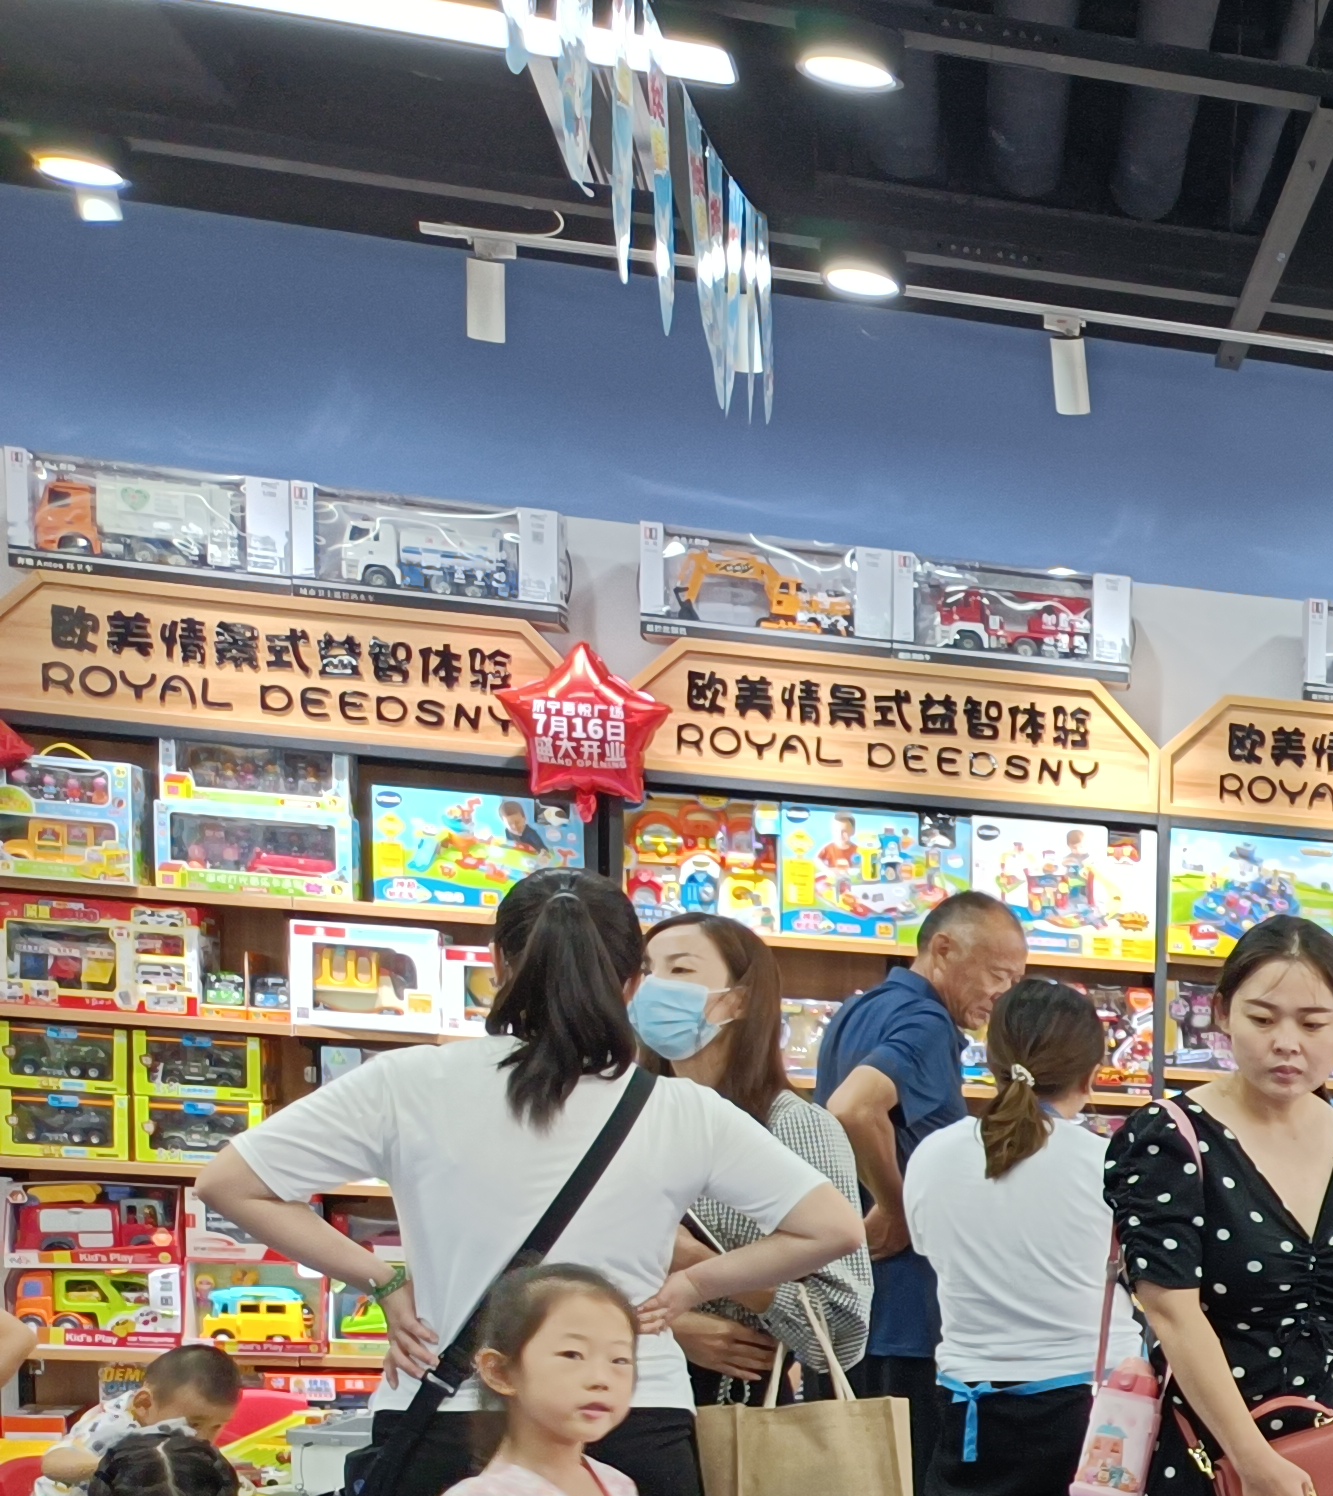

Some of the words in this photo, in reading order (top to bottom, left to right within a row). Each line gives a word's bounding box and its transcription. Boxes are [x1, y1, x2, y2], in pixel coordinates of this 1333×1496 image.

[49, 604, 512, 694] 欧美情景式益智体验
[41, 661, 234, 710] ROYAL
[260, 684, 513, 735] DEEDSNY
[687, 670, 1091, 749] 欧美情景式益智体验
[532, 714, 625, 741] 7月16日
[535, 736, 626, 763] 盛大开业
[676, 723, 843, 768] ROYAL
[867, 741, 1099, 787] DEEDSNY
[110, 1254, 133, 1264] Play
[95, 1334, 118, 1345] Play
